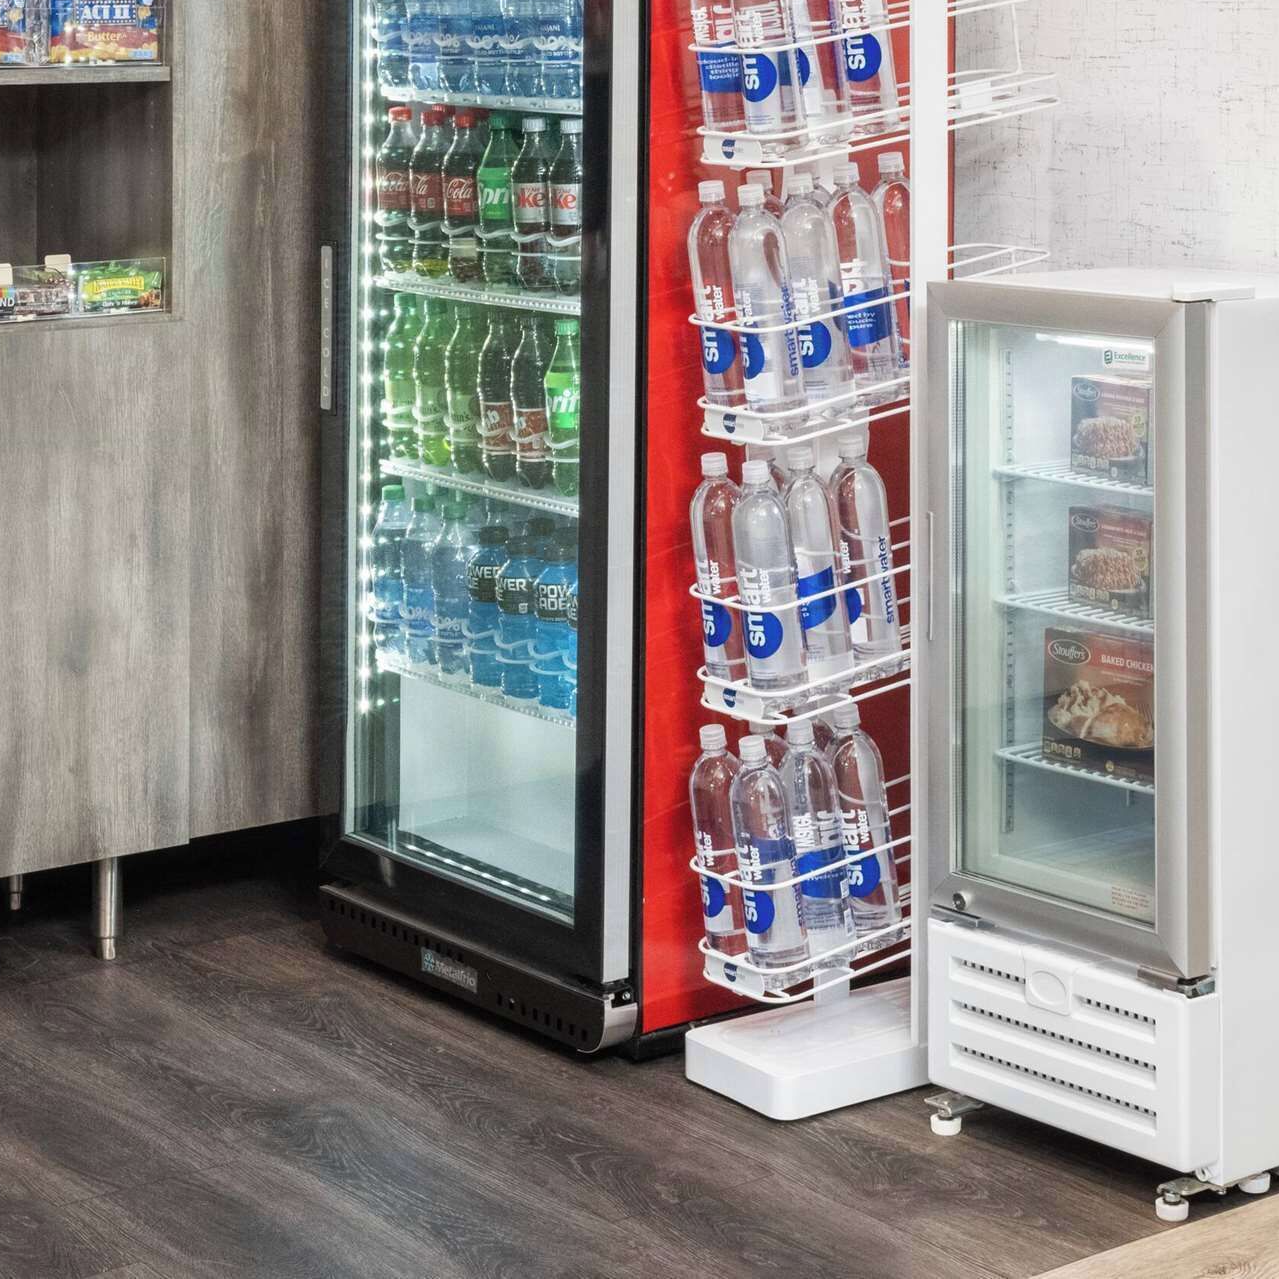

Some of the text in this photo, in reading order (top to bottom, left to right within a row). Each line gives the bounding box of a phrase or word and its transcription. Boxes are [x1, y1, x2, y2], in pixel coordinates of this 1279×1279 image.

[81, 4, 131, 20] ACT II
[87, 31, 121, 41] Butter
[1114, 352, 1146, 361] Excellence
[708, 560, 721, 595] water
[1053, 642, 1086, 660] Stouffer's
[1101, 654, 1125, 667] BAKED
